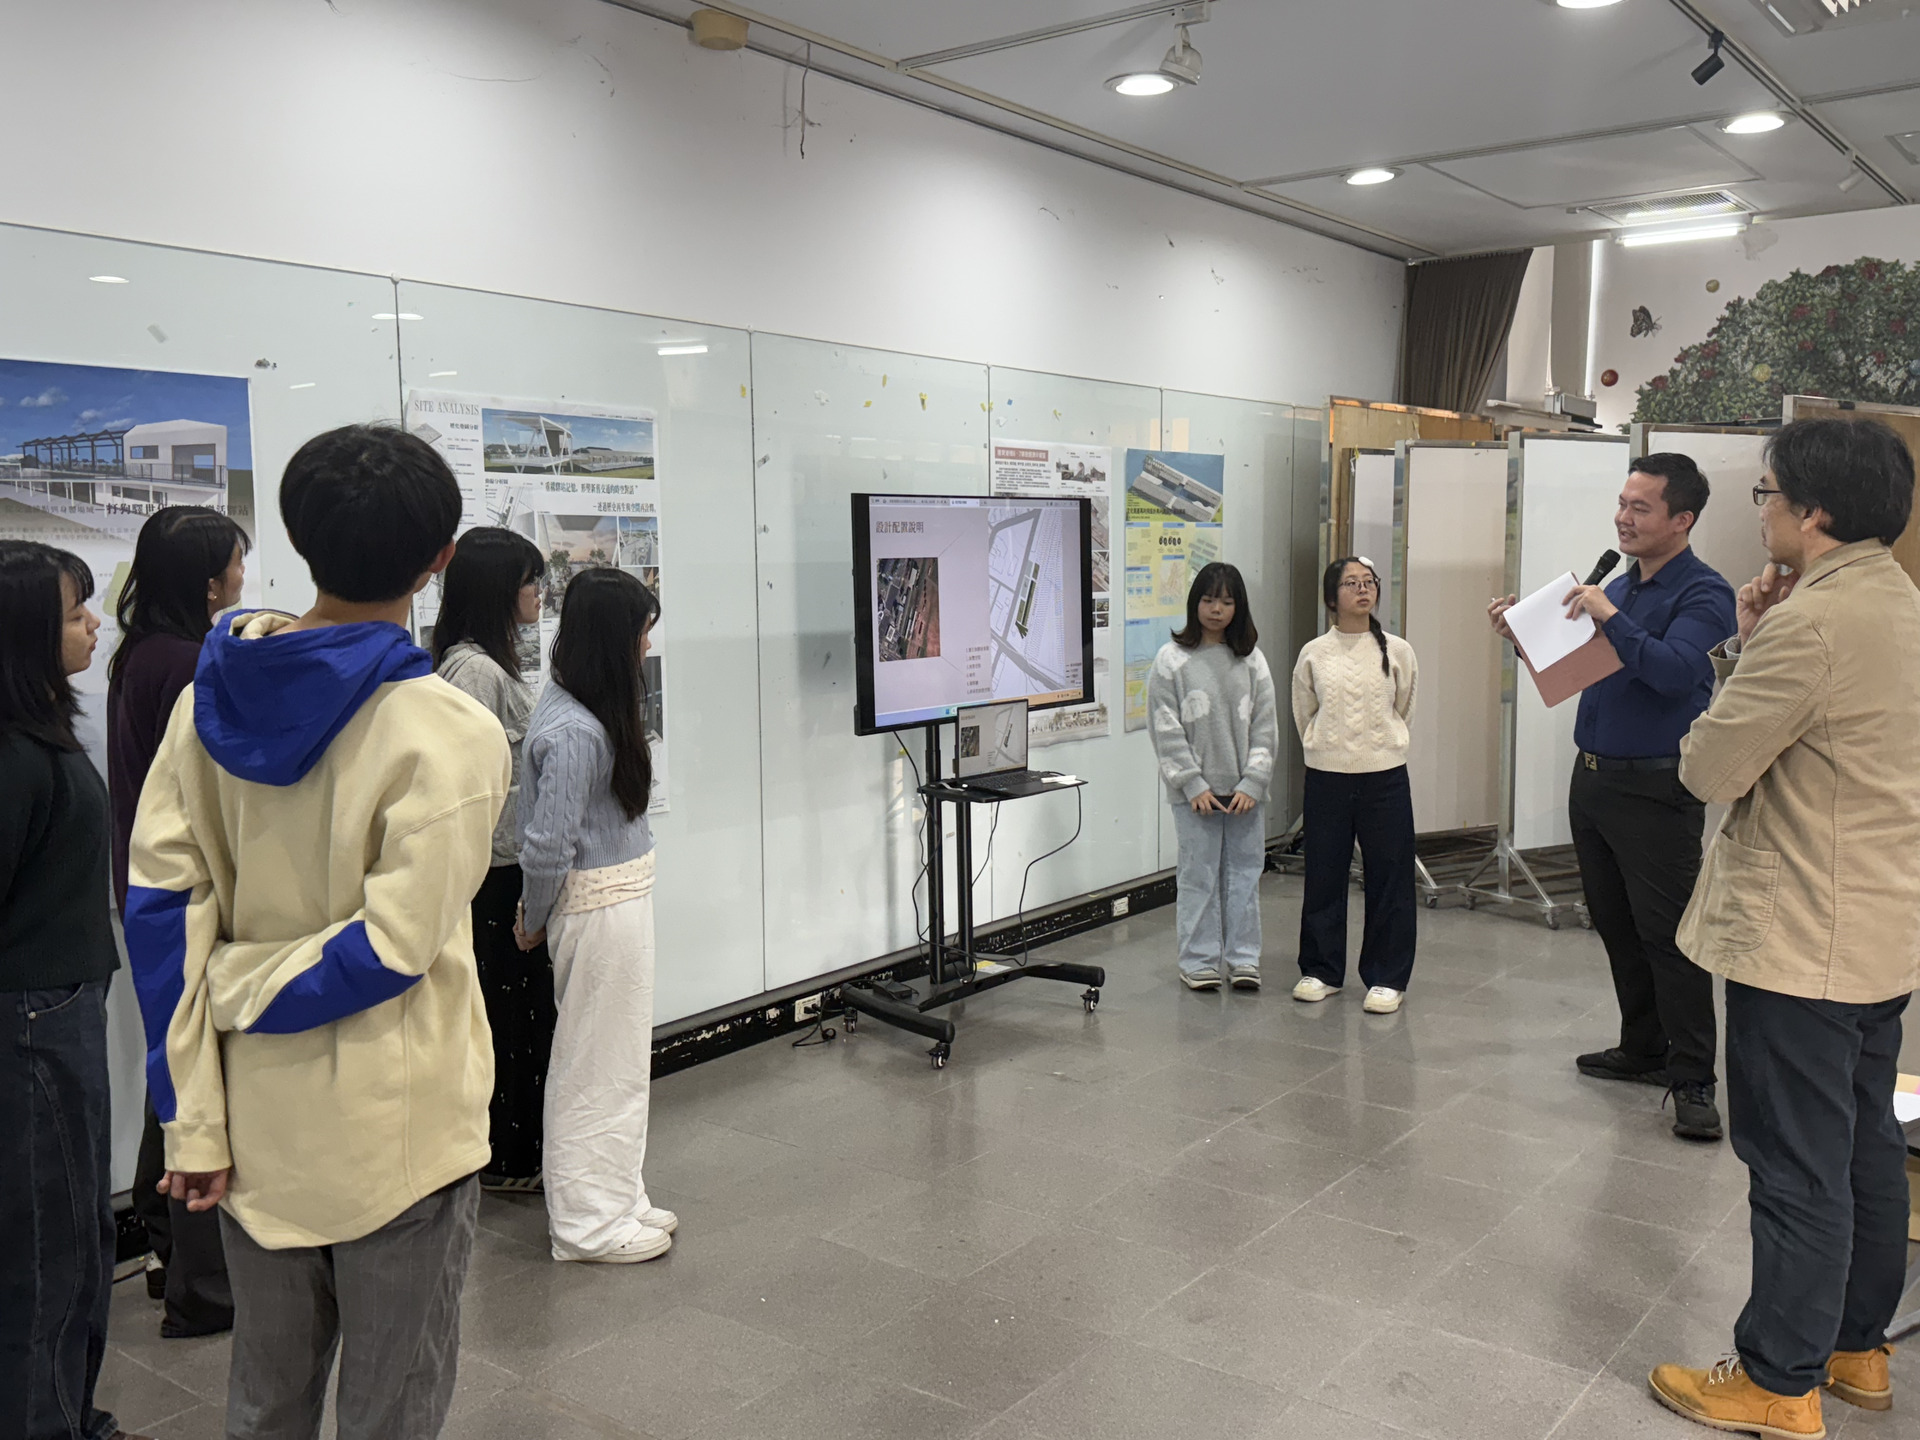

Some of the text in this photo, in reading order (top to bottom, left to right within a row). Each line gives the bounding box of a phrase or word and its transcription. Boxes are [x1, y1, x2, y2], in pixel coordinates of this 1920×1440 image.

[414, 400, 480, 415] SITE ANALYSIS
[875, 521, 924, 534] 設計配置說明
